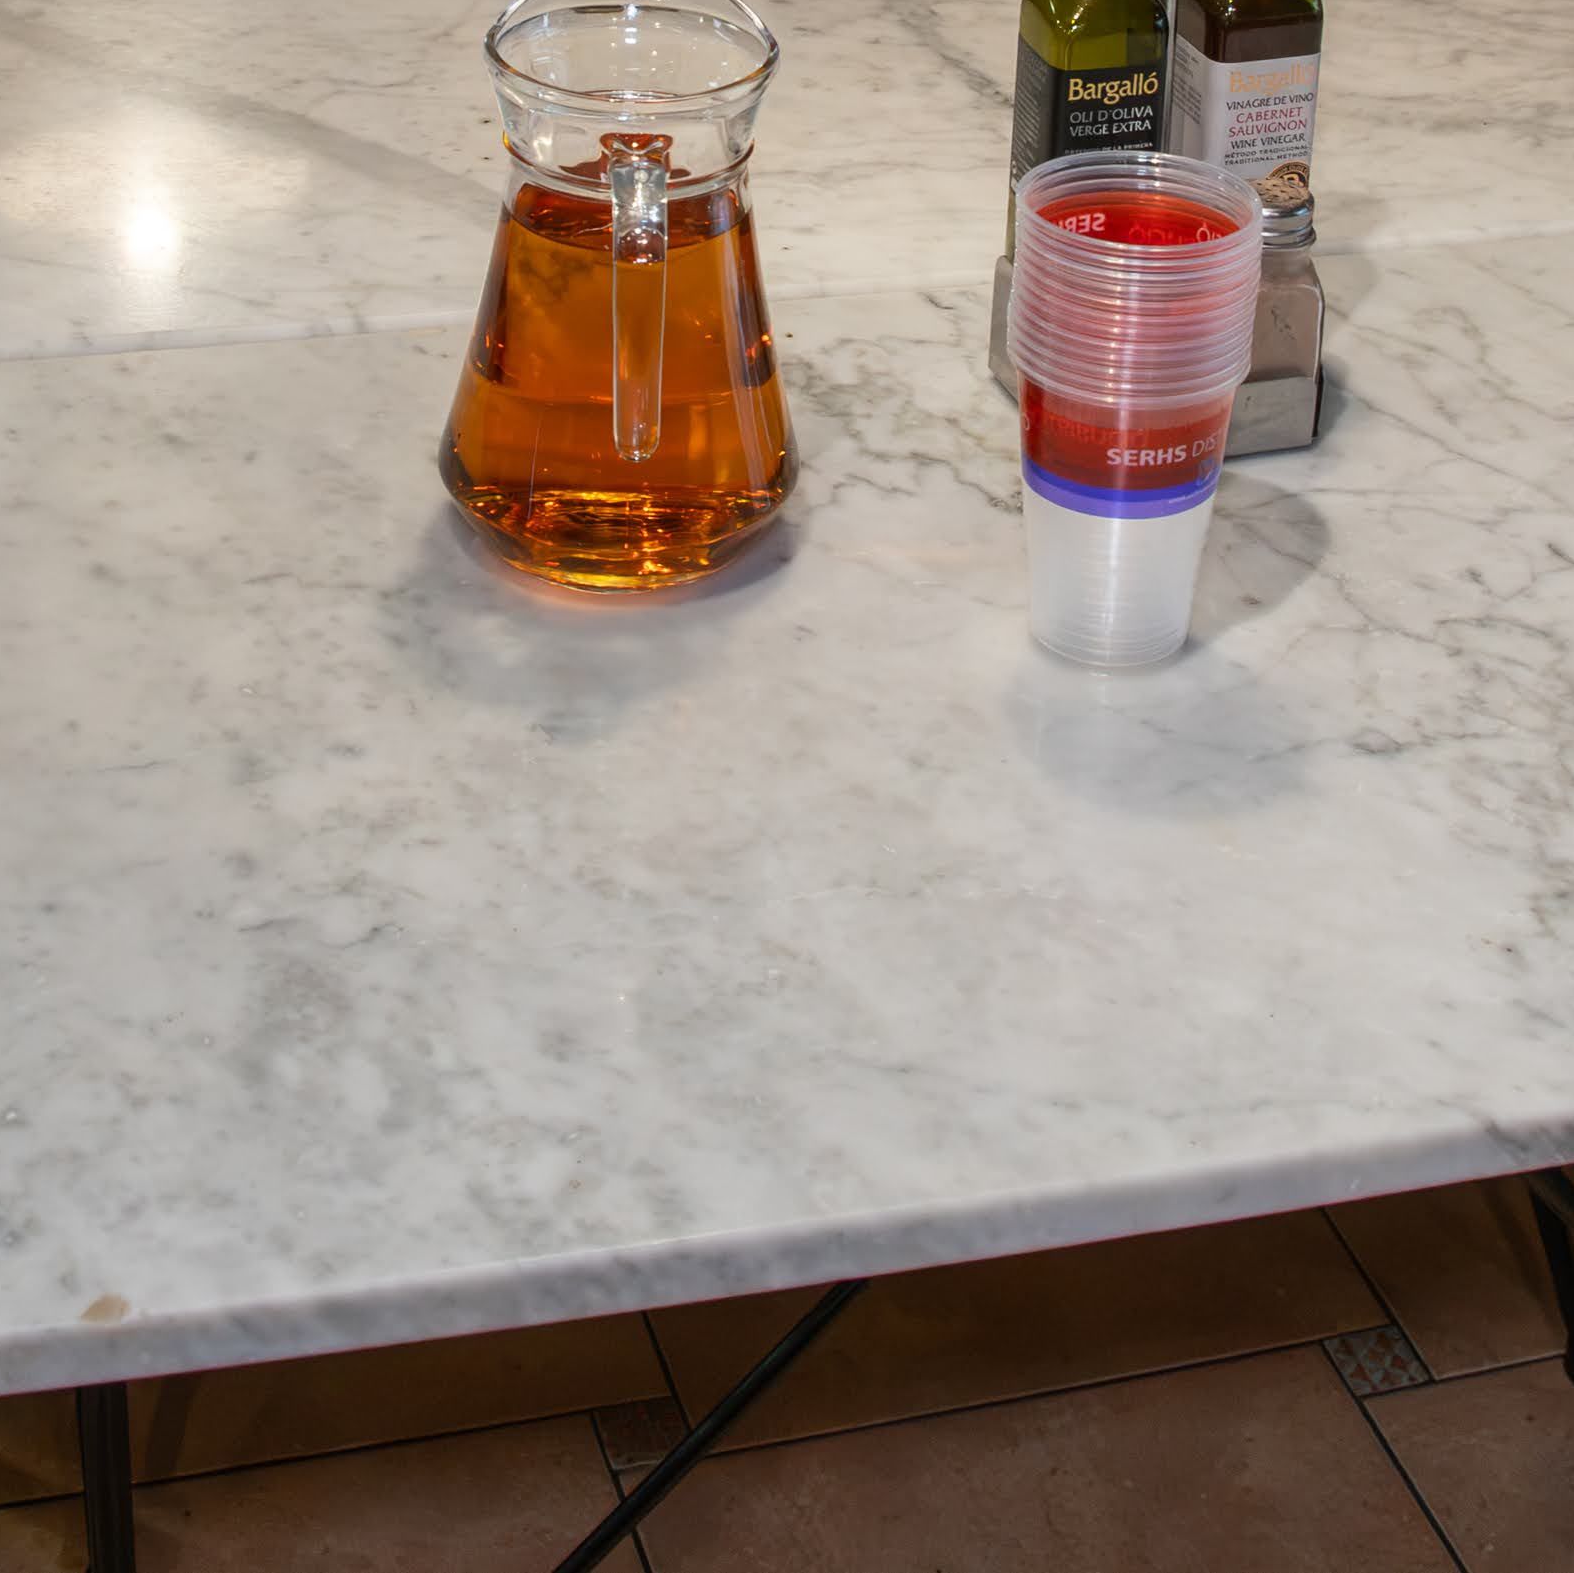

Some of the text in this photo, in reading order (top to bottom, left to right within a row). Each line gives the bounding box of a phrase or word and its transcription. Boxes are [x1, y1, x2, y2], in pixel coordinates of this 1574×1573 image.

[1067, 72, 1159, 105] Bargalló
[1226, 92, 1314, 111] VINAGRE DE VINO
[1070, 110, 1093, 124] OLI
[1236, 106, 1303, 124] CABERNET
[1069, 119, 1152, 137] VERGE EXTRA
[1228, 118, 1307, 138] SAUVIGNON
[1230, 132, 1306, 150] WINE VINEGAR
[1106, 445, 1187, 467] SERHS
